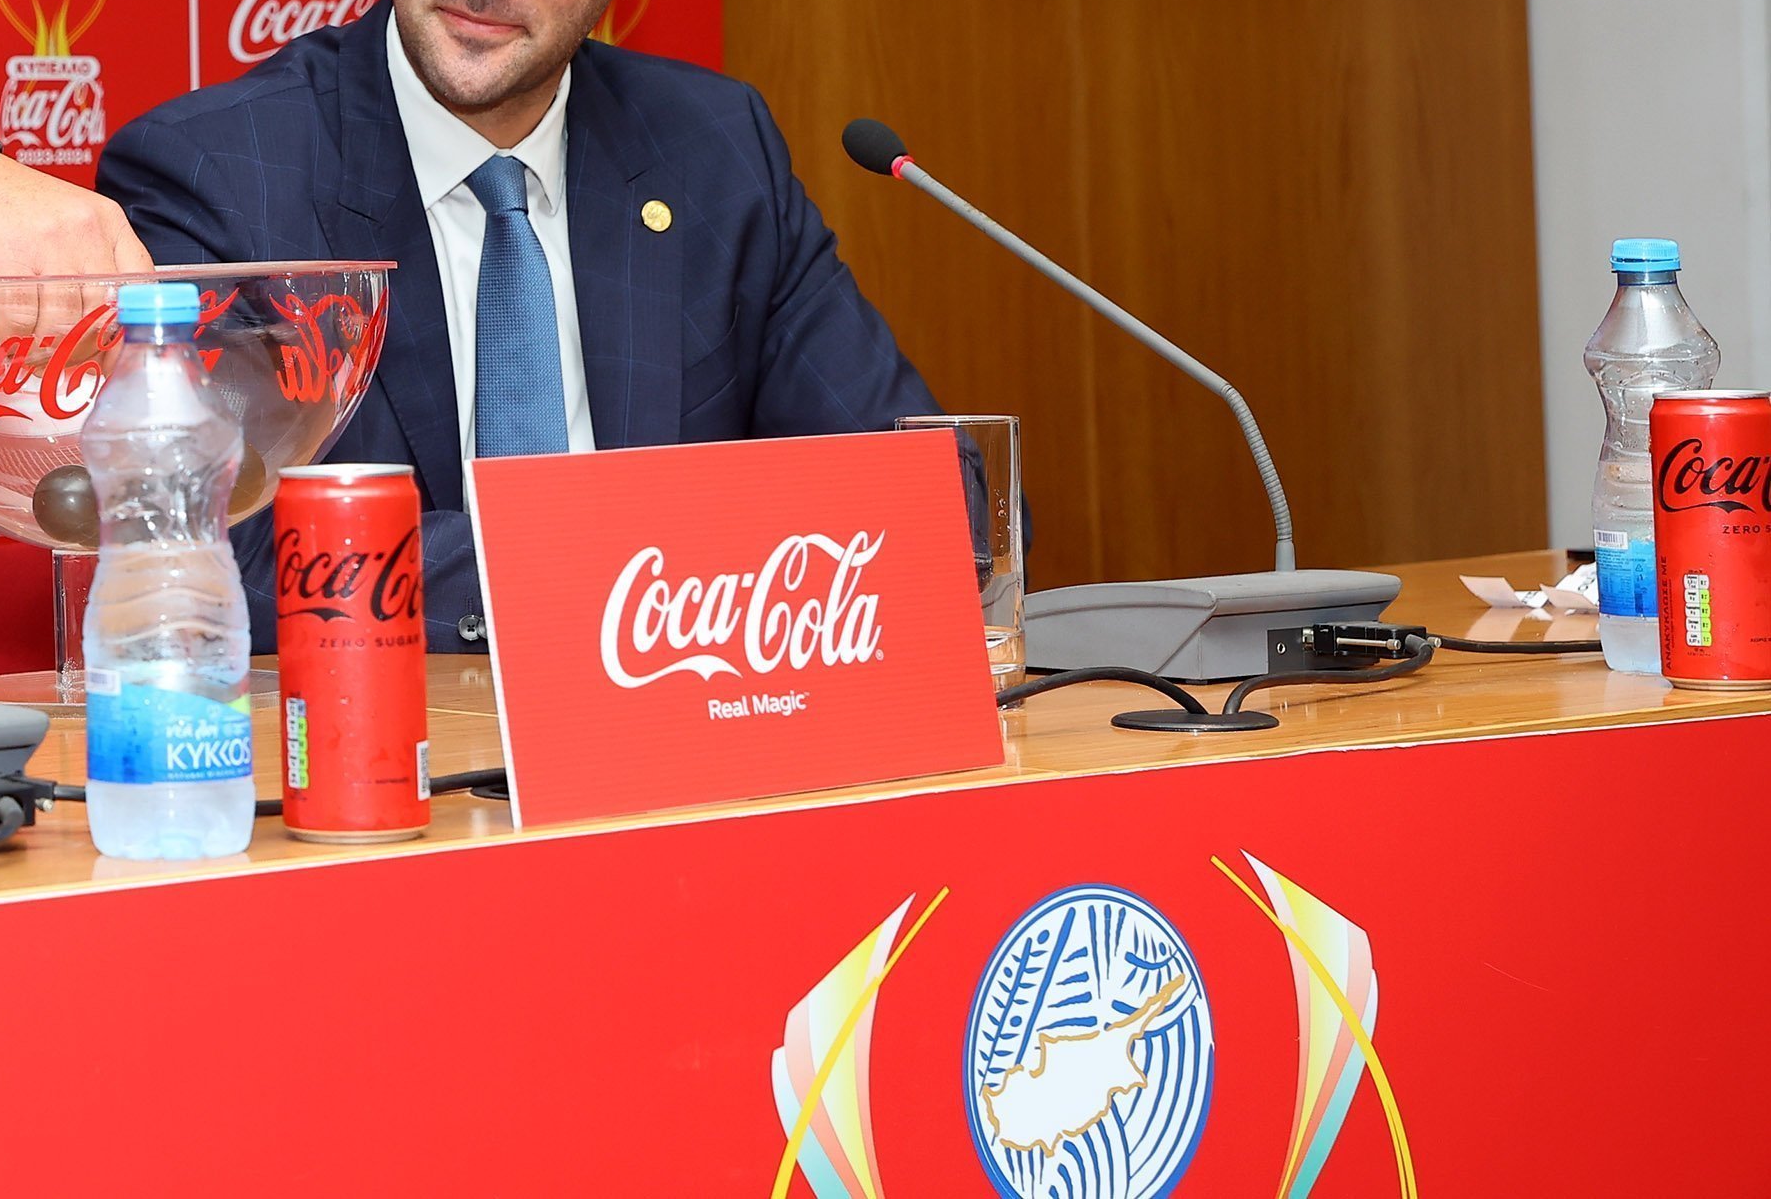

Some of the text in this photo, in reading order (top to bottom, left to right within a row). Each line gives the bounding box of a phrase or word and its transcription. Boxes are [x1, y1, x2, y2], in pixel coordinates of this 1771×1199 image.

[1722, 525, 1761, 535] ZERO
[600, 529, 885, 689] Coca-Cola
[319, 634, 421, 649] ZERO SUGAR
[708, 690, 807, 721] Real Magic
